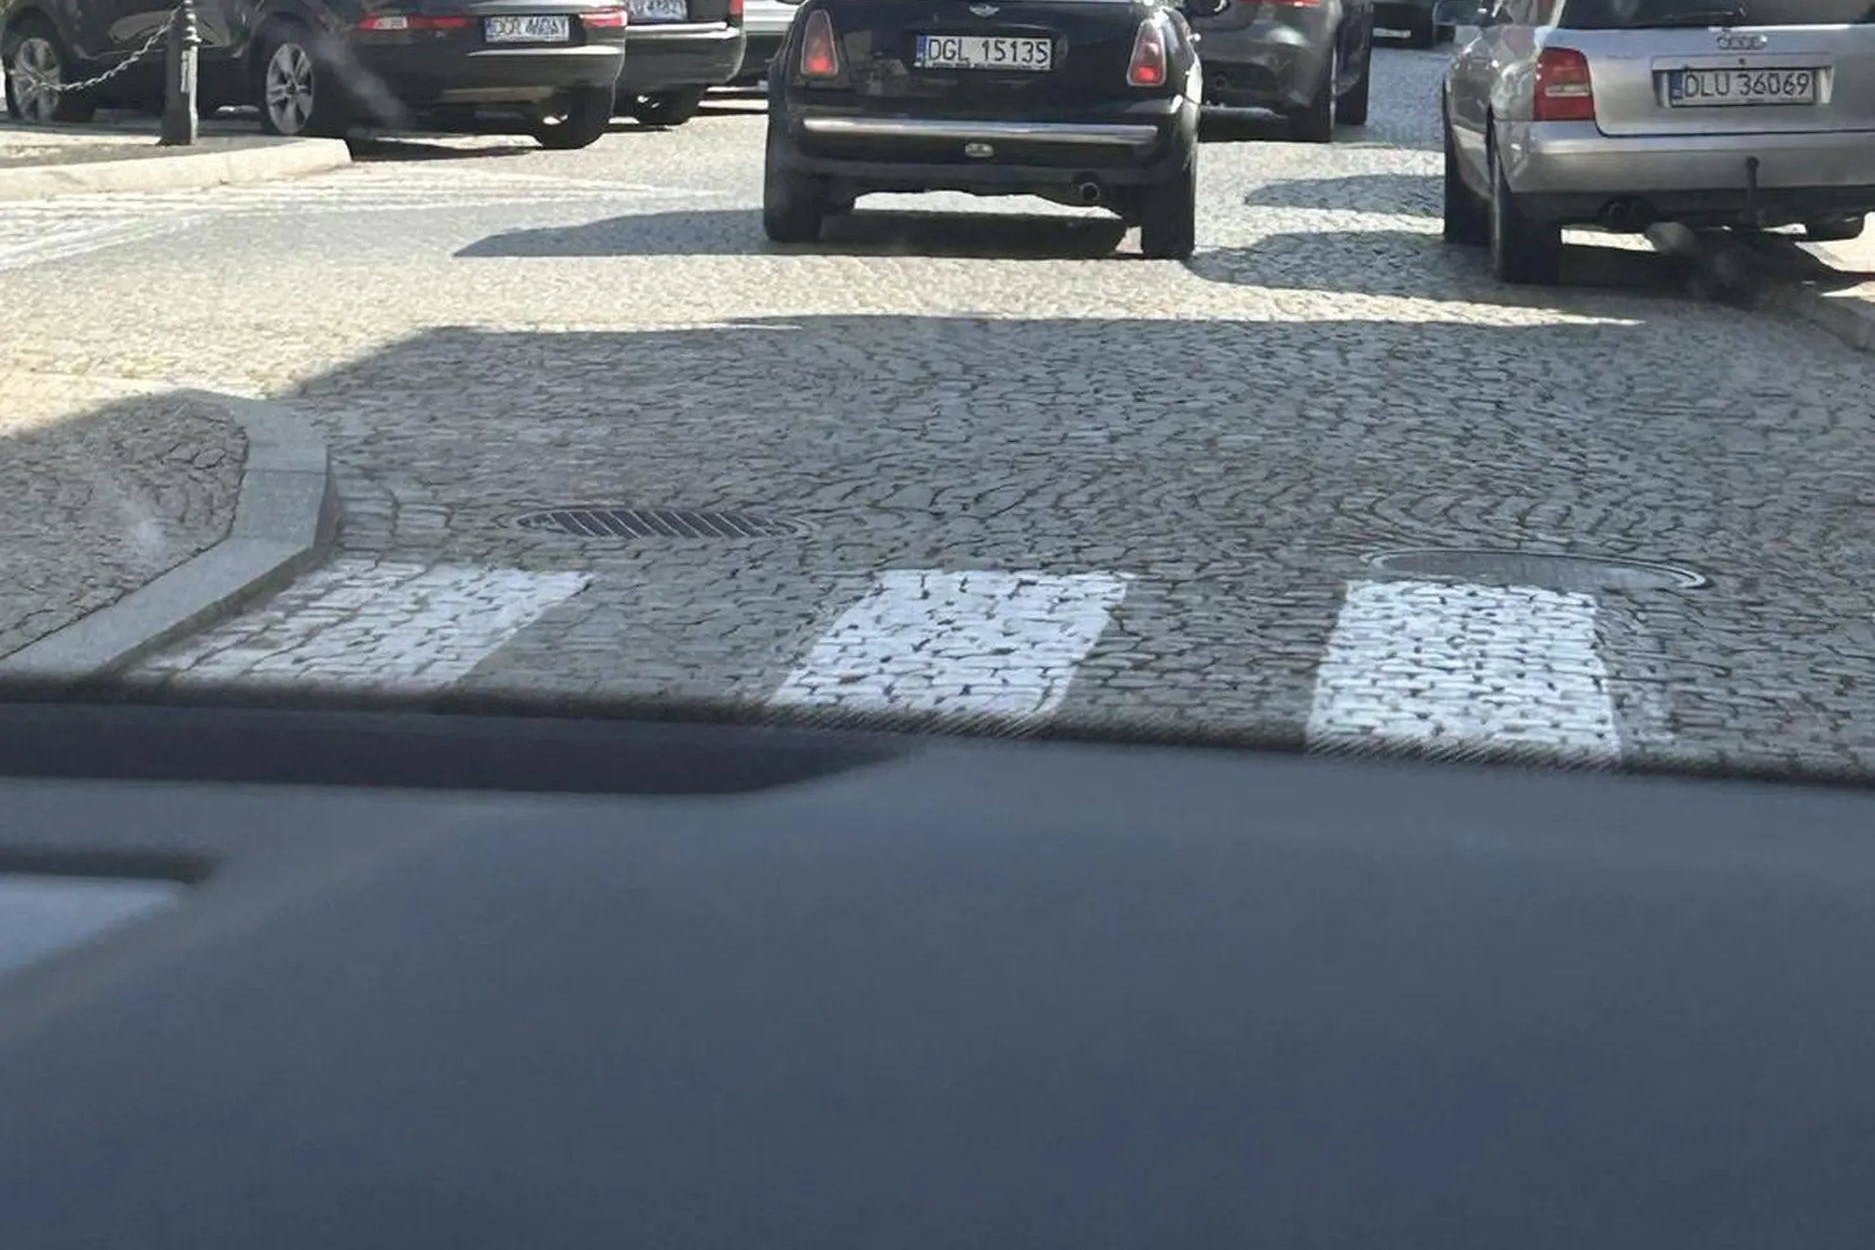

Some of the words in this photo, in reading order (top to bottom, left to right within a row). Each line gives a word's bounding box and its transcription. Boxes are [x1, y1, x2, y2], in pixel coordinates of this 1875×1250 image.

[928, 38, 970, 61] DGL
[981, 40, 1049, 64] 15135
[1684, 73, 1730, 97] DLU
[1736, 72, 1810, 96] 36069
